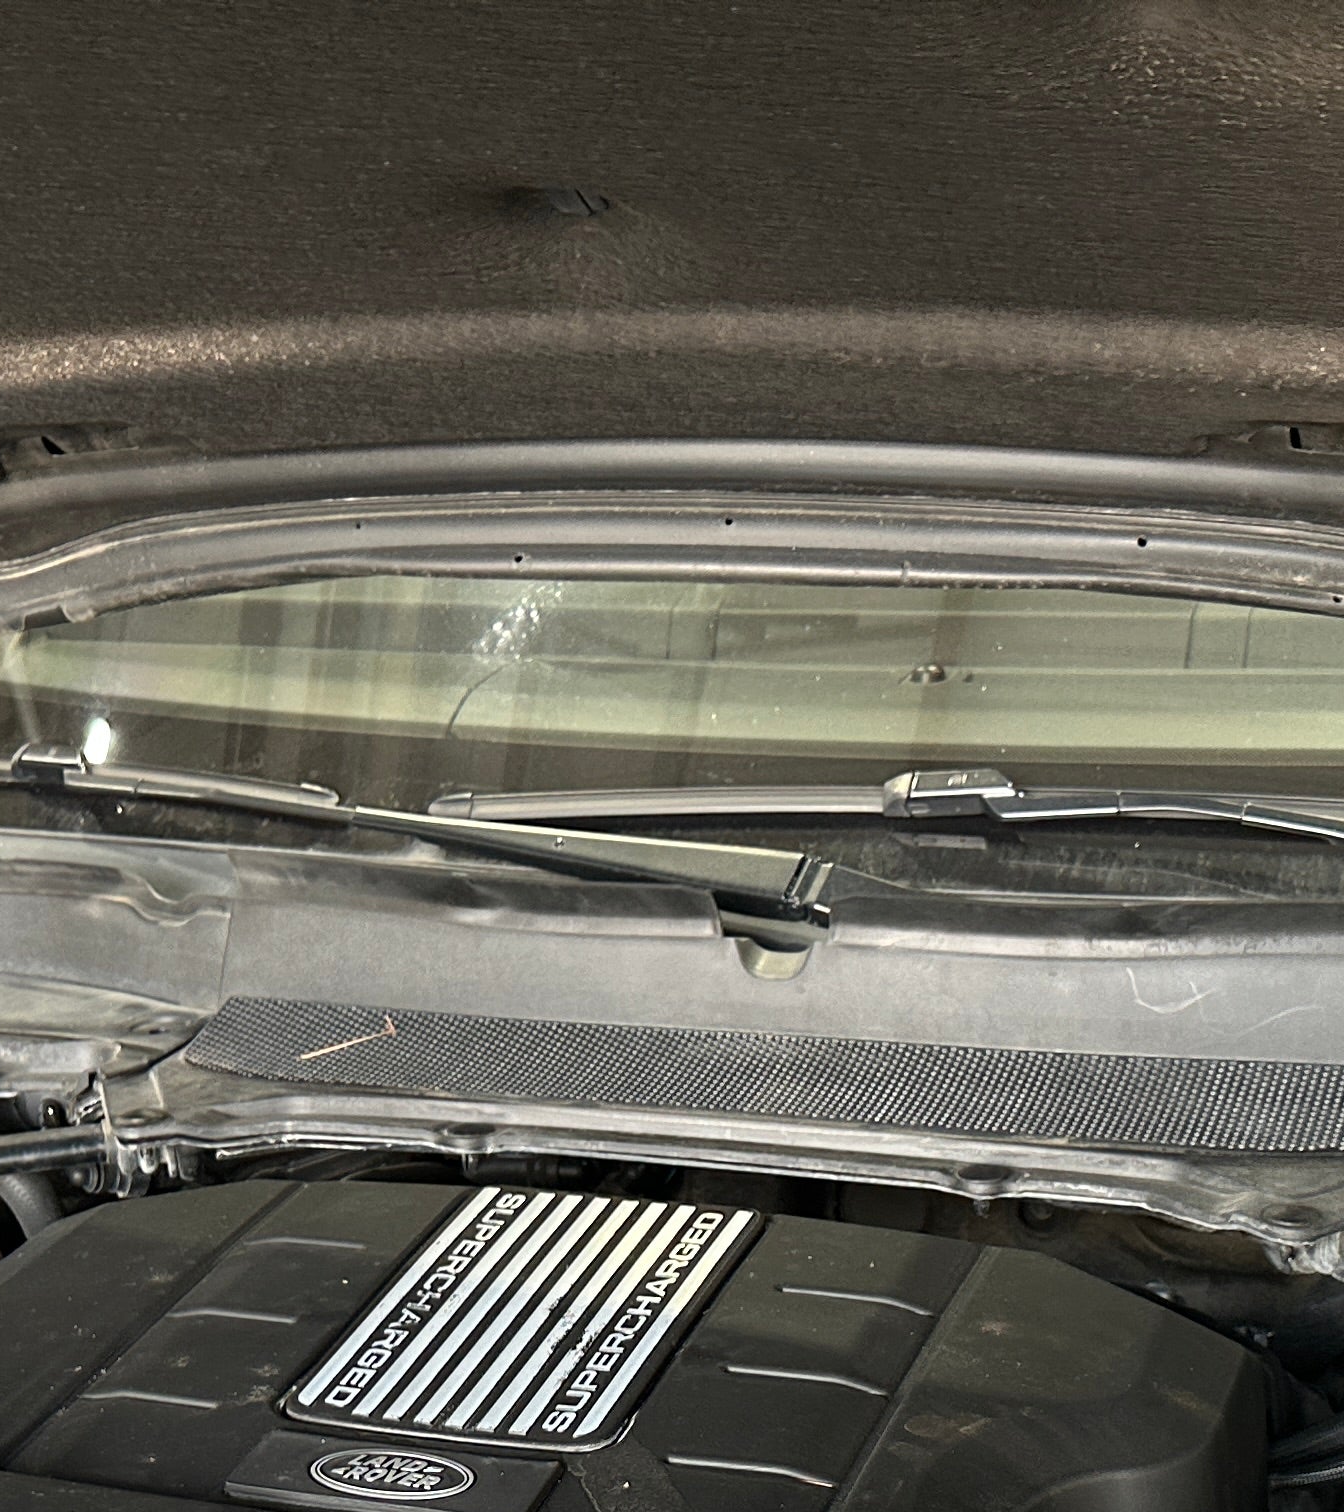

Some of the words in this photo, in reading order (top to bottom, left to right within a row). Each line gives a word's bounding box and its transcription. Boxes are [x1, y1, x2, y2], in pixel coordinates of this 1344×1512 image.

[325, 1193, 527, 1408] SUPERCHARGED
[541, 1211, 724, 1433] SUPERCHARGED
[342, 1466, 442, 1491] ROVER
[348, 1453, 429, 1474] LAND
